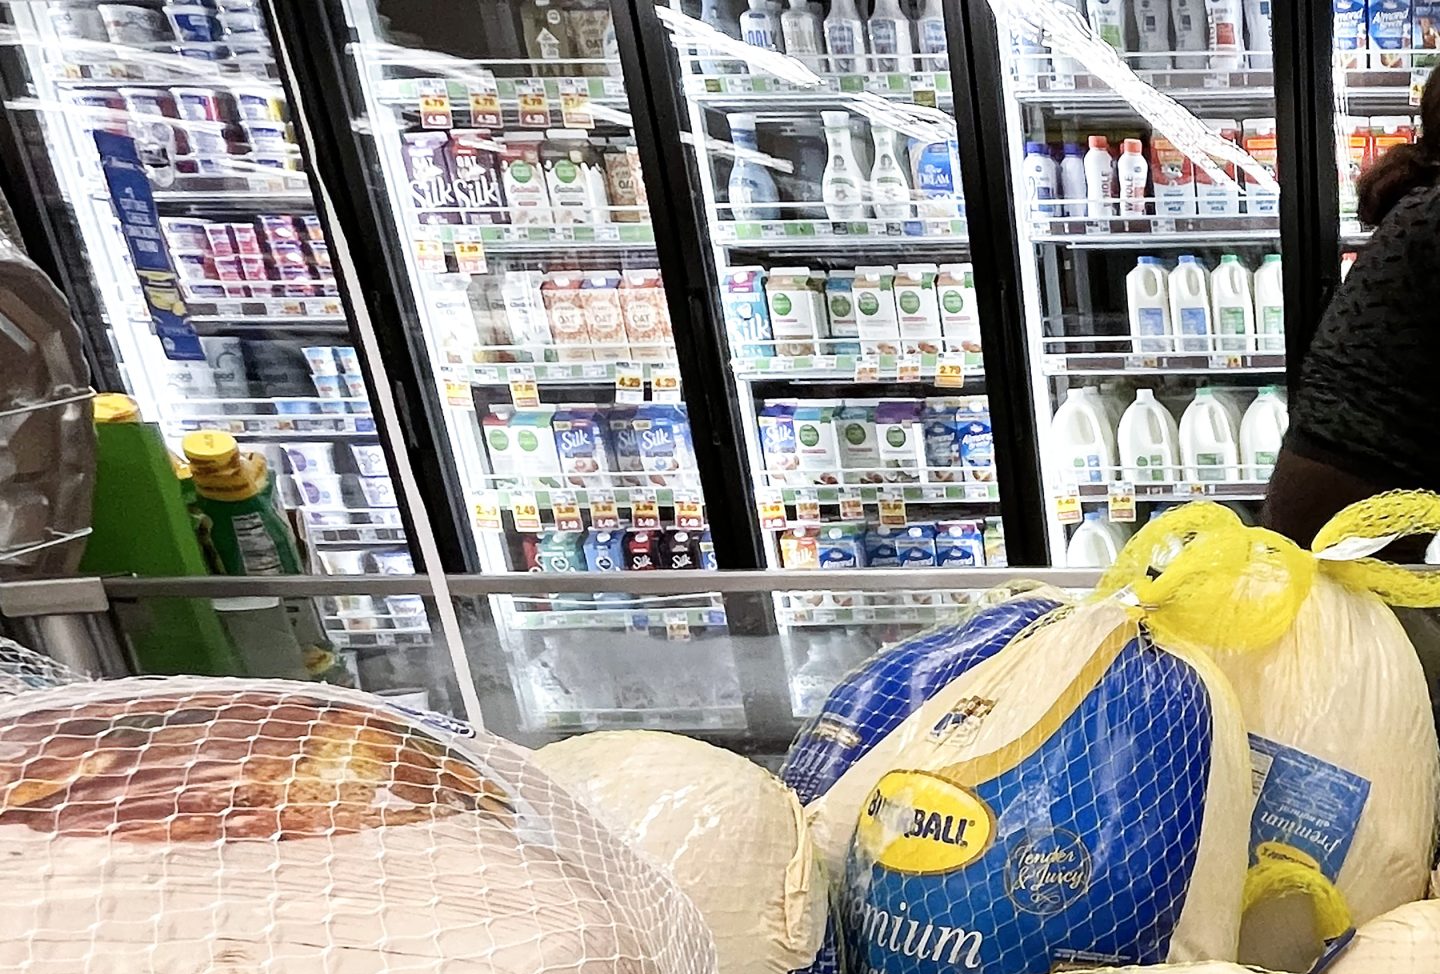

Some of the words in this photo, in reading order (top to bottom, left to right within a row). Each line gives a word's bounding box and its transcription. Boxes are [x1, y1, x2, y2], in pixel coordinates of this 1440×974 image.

[410, 179, 453, 208] Silk
[452, 175, 502, 208] Silk
[562, 429, 592, 451] Silk
[642, 427, 672, 449] Silk
[765, 425, 793, 444] Silk
[514, 504, 536, 515] 2.49
[632, 555, 653, 570] Silk
[671, 554, 692, 569] Silk
[1260, 810, 1343, 853] Premium
[1016, 845, 1077, 869] Tender
[1014, 869, 1029, 891] &
[1033, 867, 1087, 892] Juicy
